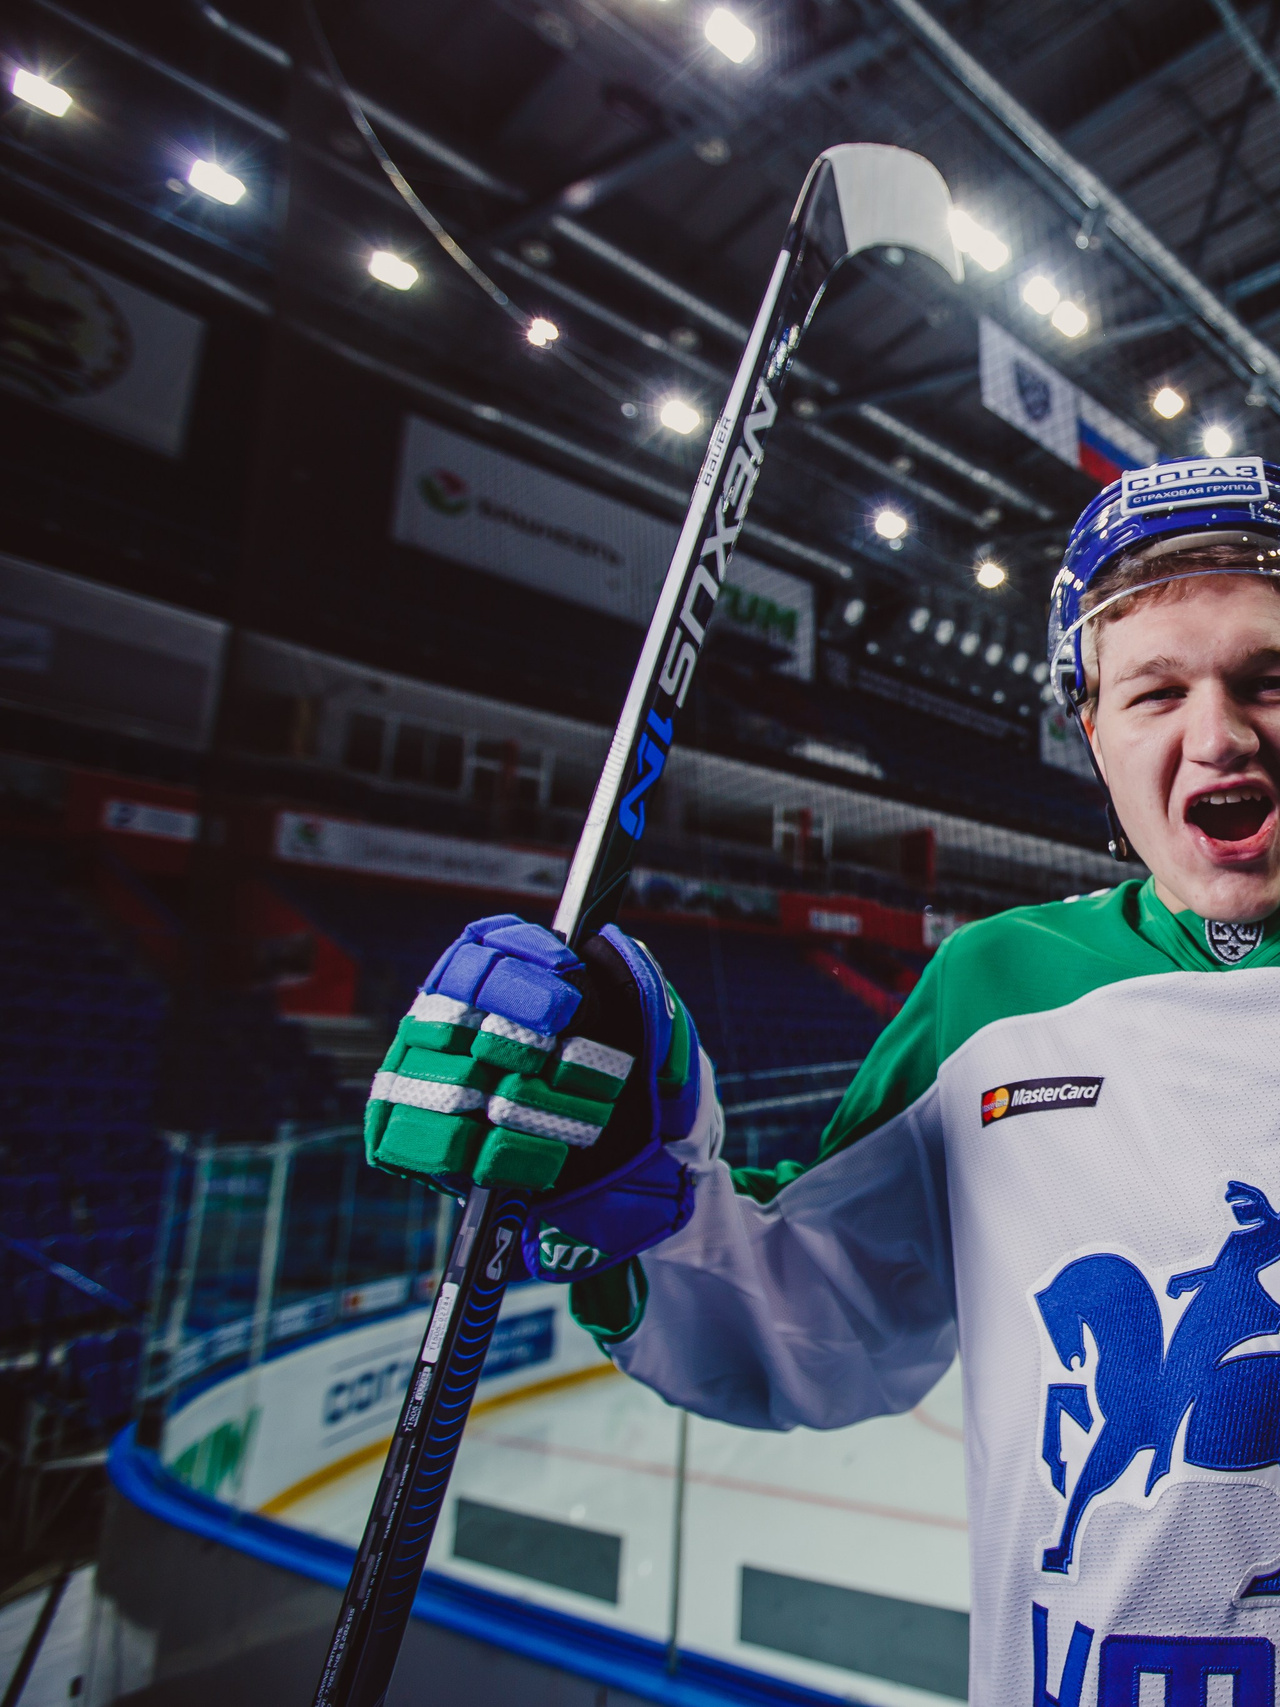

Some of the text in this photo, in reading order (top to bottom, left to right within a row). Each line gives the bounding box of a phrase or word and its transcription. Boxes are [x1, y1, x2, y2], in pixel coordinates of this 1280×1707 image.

[702, 415, 731, 487] BAUER
[1128, 465, 1258, 492] СОГАЗ
[1132, 484, 1256, 505] СТРАХОВАЯ ГРУППА
[658, 377, 778, 709] NEXUS
[1011, 1083, 1099, 1107] MasterCard
[373, 1551, 384, 1576] CHINA
